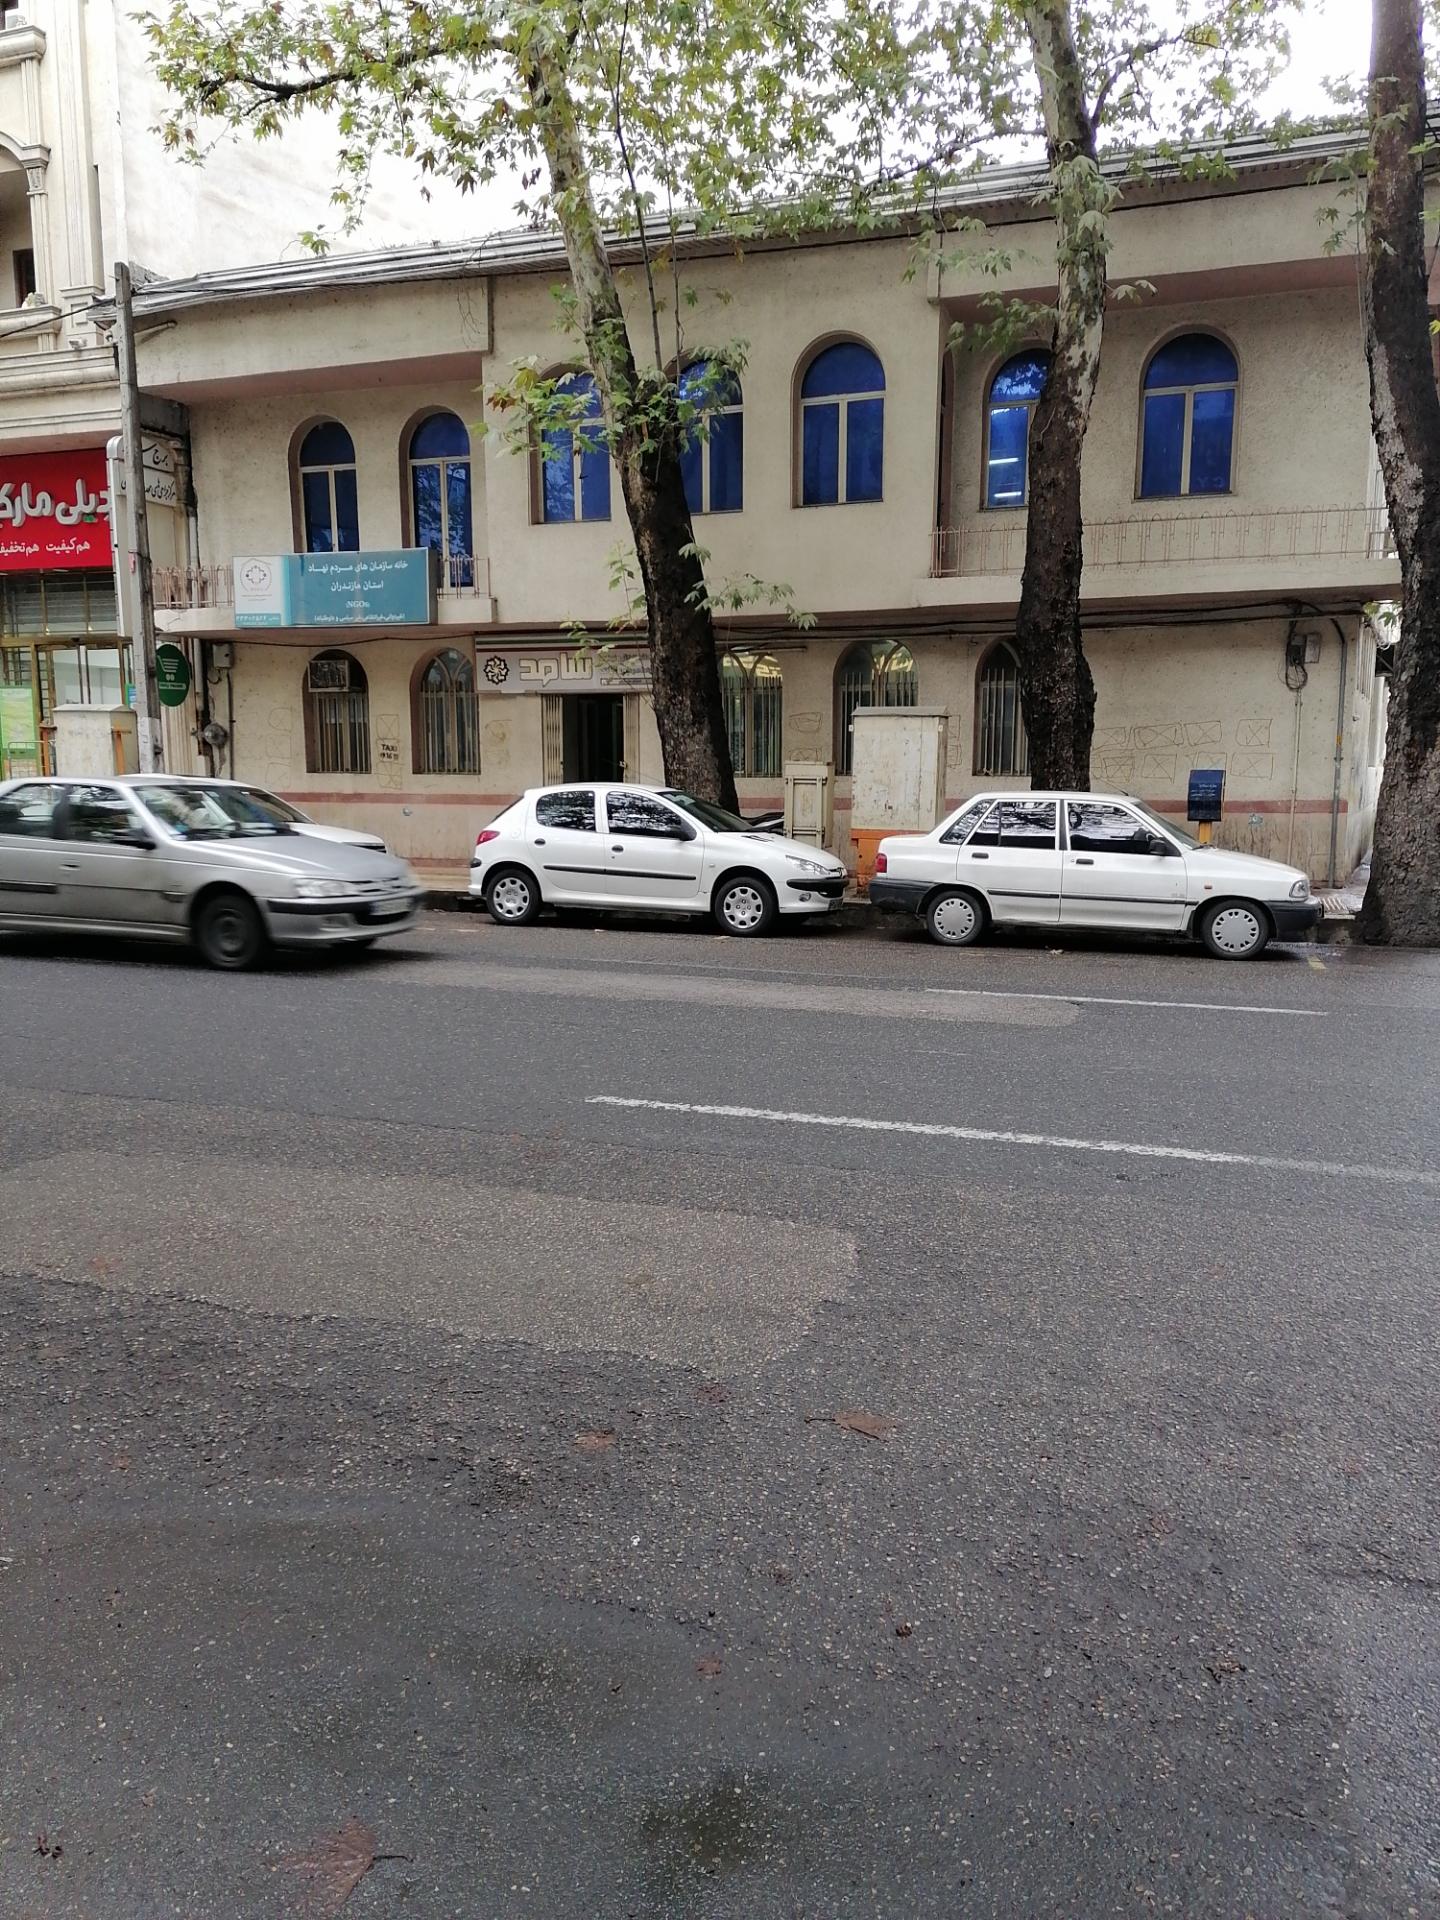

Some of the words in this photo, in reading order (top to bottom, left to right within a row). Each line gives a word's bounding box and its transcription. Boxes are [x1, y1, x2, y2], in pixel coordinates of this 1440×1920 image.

[45, 537, 77, 554] کیفیت
[354, 562, 368, 573] های
[368, 560, 393, 572] سازمان
[394, 560, 408, 569] خانه
[330, 582, 361, 592] مازندران
[363, 580, 384, 591] استان
